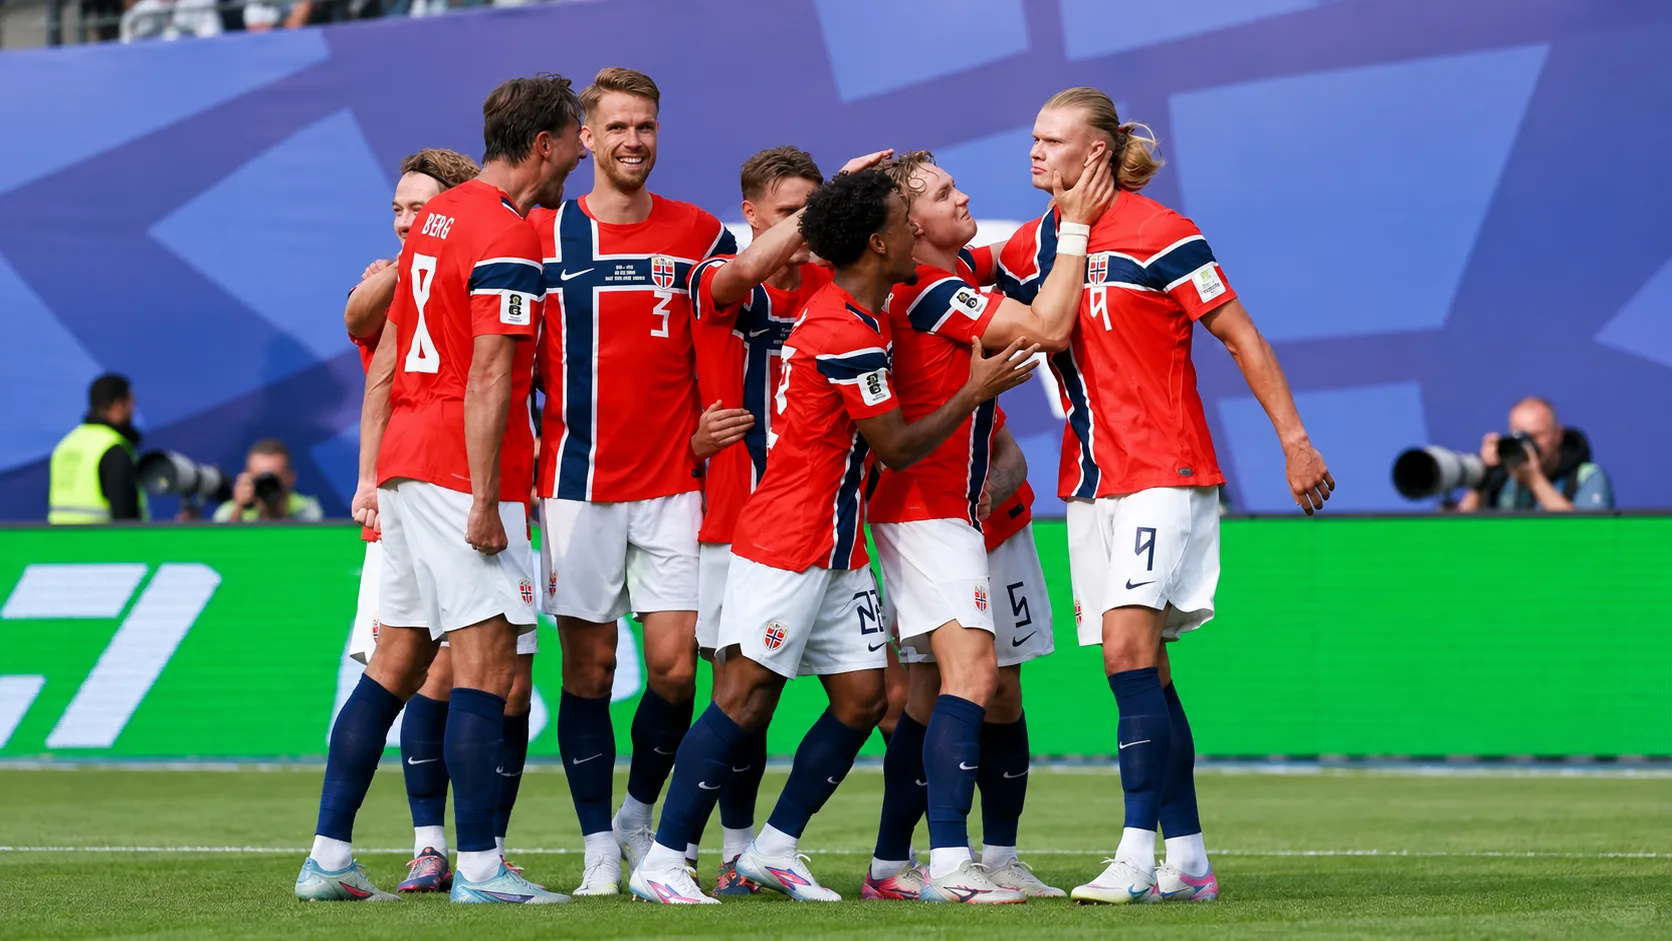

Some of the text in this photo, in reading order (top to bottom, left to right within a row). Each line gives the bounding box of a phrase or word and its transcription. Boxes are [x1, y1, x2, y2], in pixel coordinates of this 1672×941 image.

[421, 212, 455, 241] BERG
[404, 252, 441, 375] 8
[650, 291, 673, 338] 3
[1089, 286, 1113, 332] 9
[1134, 526, 1157, 571] 9
[1006, 581, 1033, 628] 5
